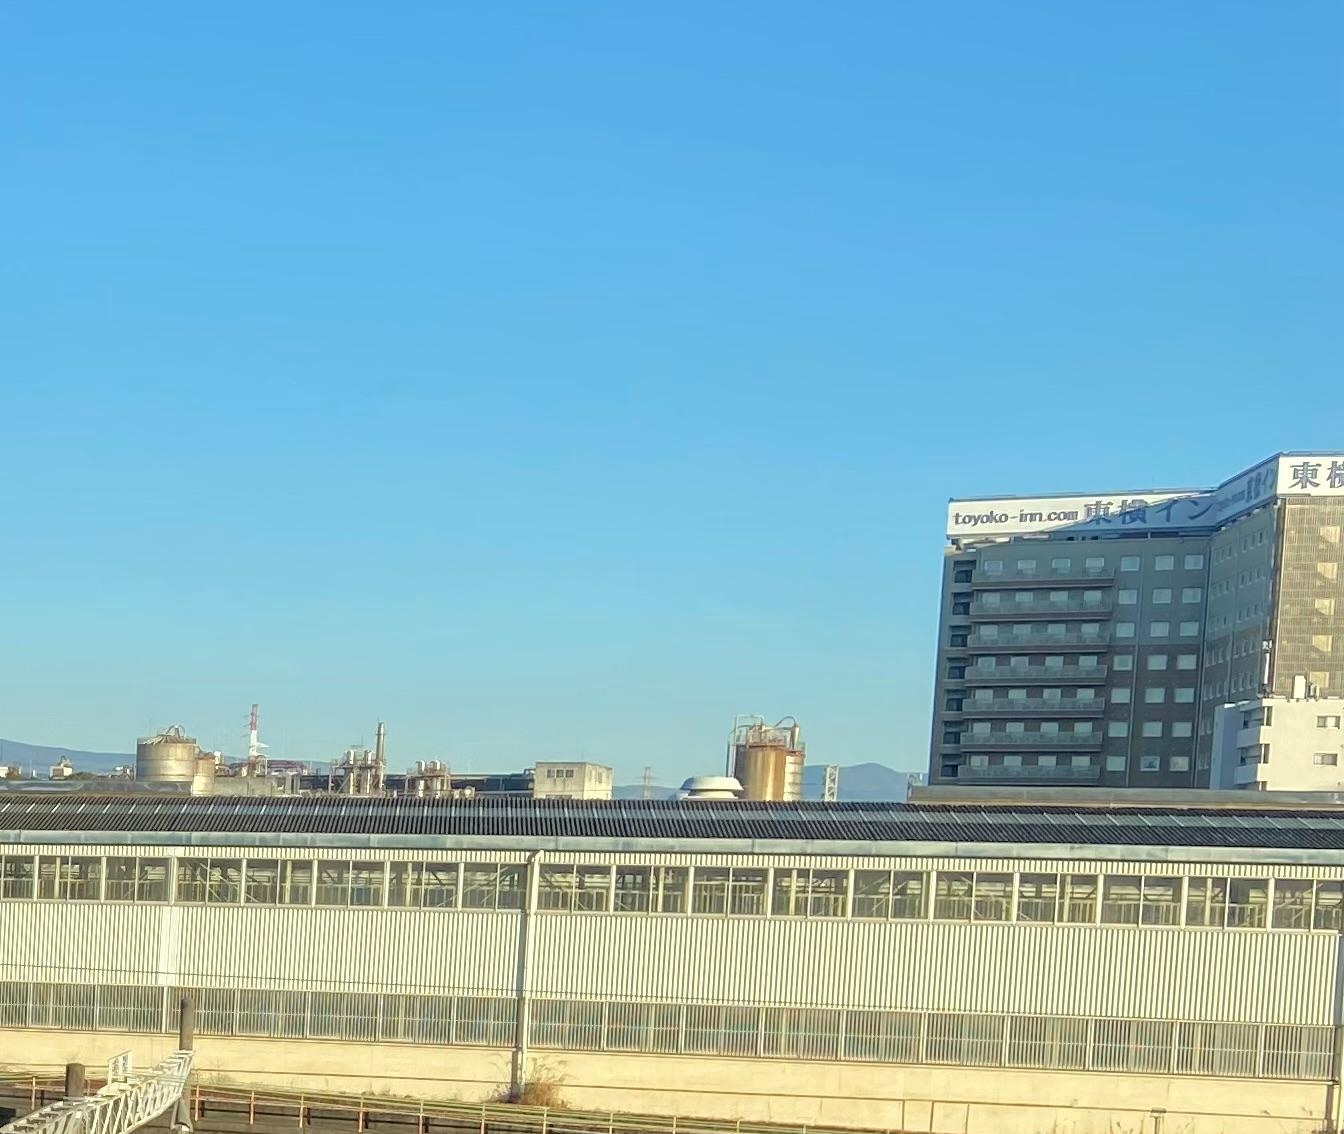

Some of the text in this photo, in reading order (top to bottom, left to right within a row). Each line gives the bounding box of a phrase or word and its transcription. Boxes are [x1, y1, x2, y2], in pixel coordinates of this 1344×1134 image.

[954, 499, 1214, 527] toyoko-inn.com 東横イン
